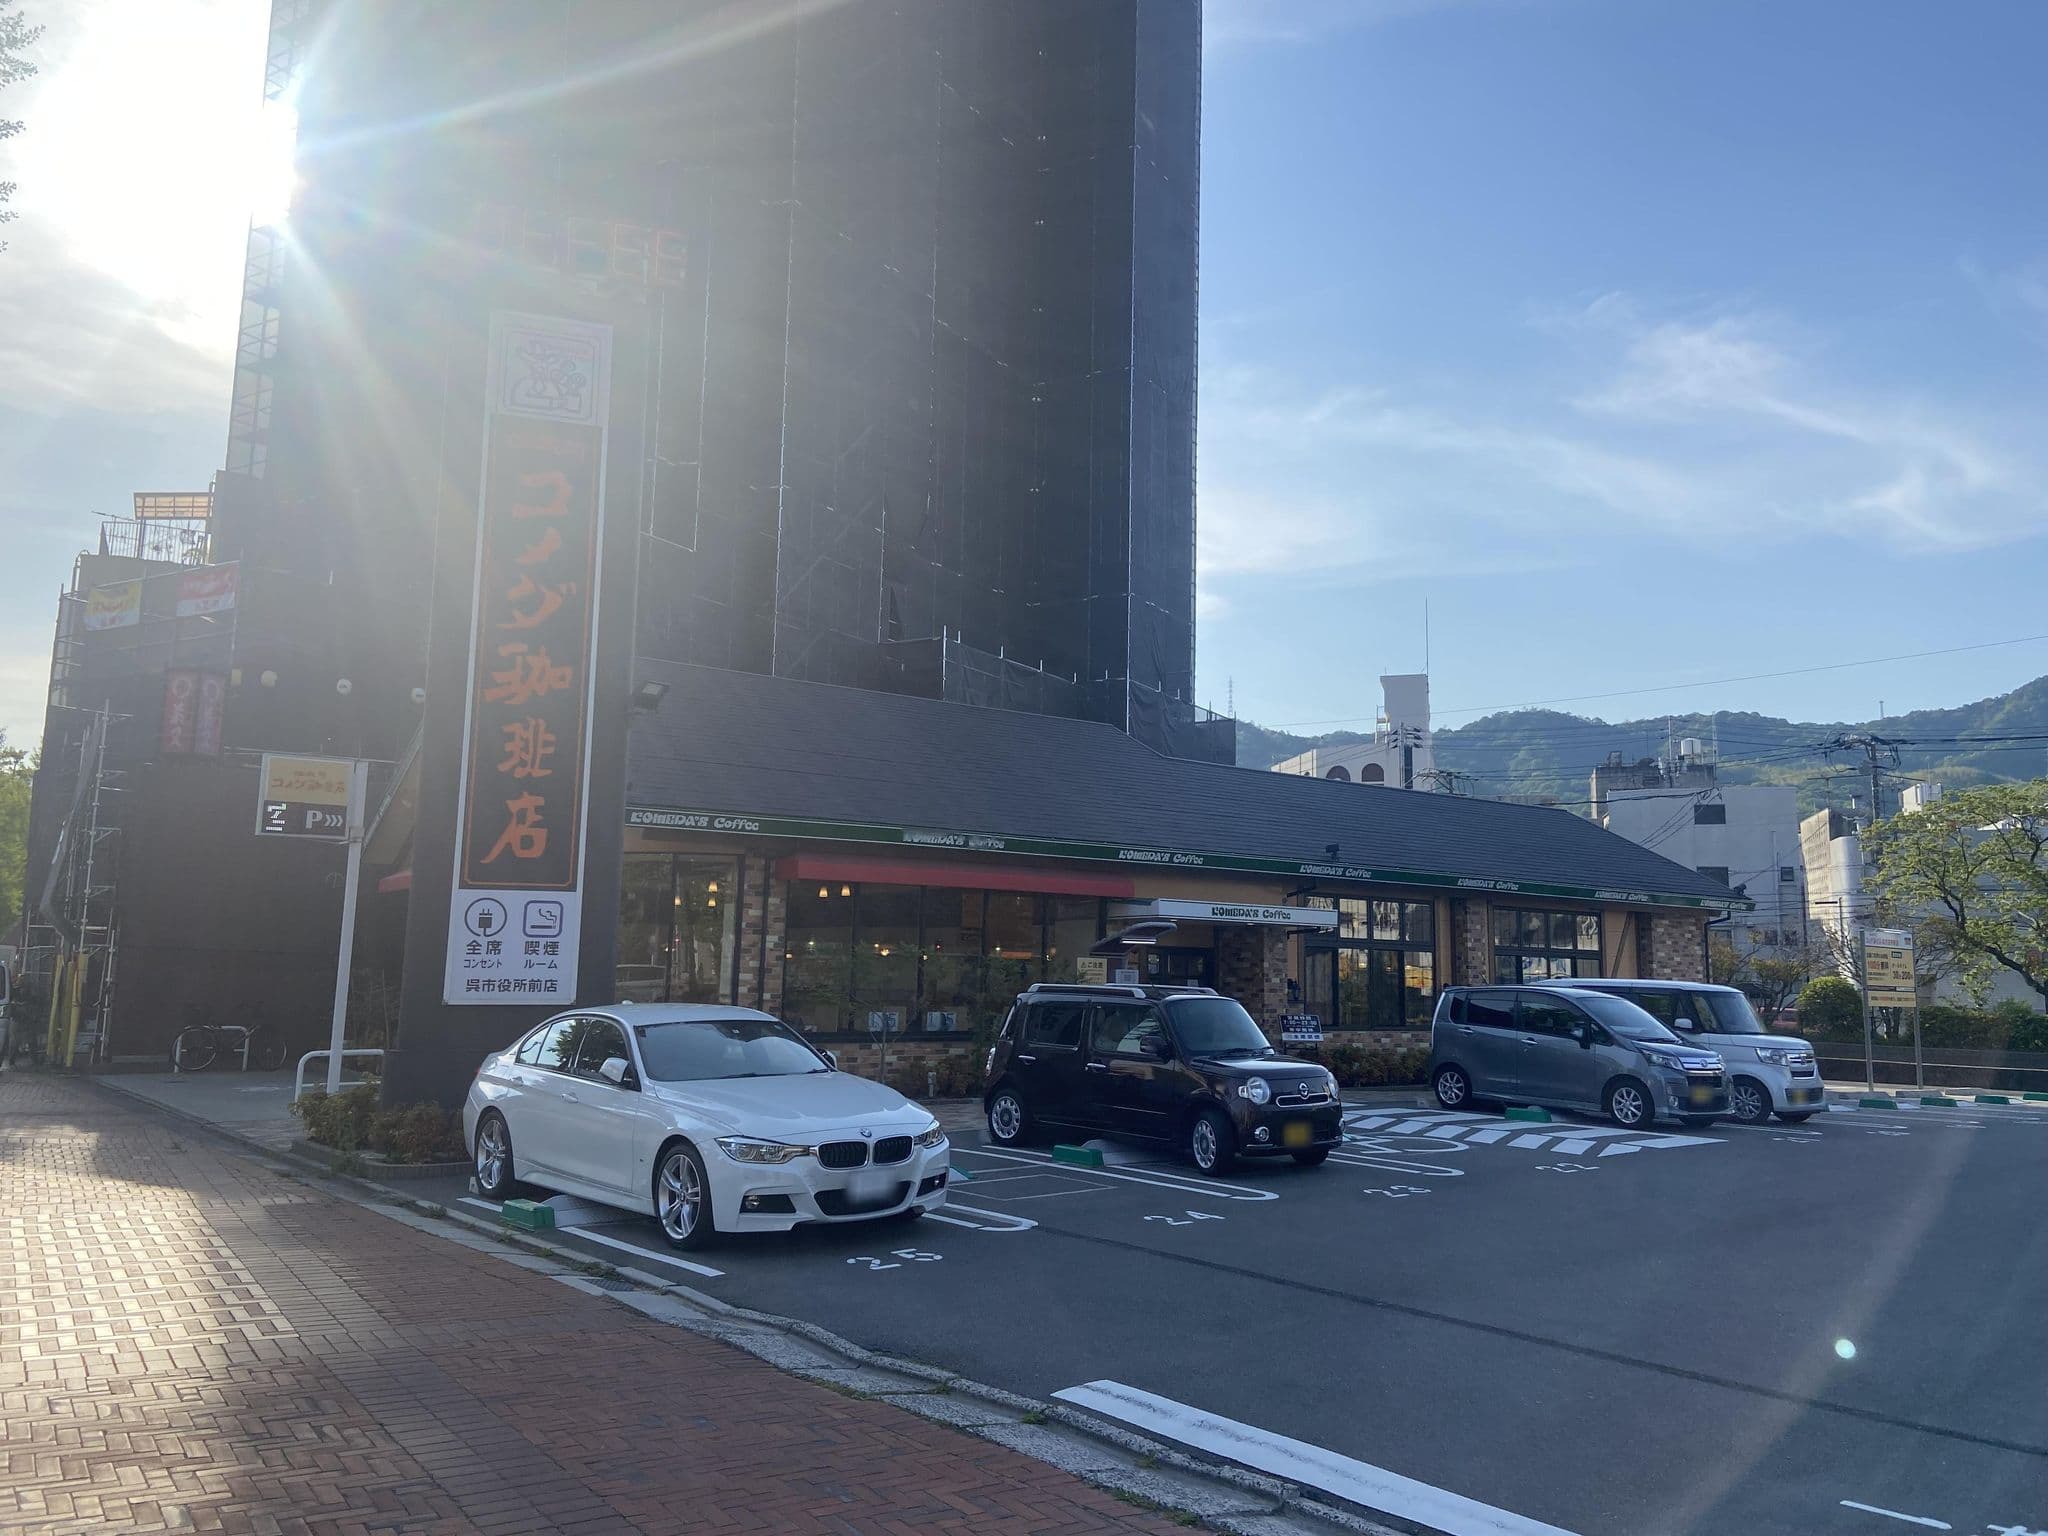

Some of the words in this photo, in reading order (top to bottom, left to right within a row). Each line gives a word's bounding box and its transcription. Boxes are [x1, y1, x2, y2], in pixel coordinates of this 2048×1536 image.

[305, 810, 323, 829] P
[630, 811, 709, 827] KOMEDA'S
[713, 817, 760, 832] Coffee
[1119, 850, 1171, 862] KOMEDA'S
[1173, 853, 1204, 865] Coffee
[1345, 868, 1372, 878] Coffee
[1211, 906, 1260, 918] KOMEDA'S
[1262, 909, 1292, 920] Coffee
[466, 939, 503, 956] 全席
[524, 941, 560, 956] 喫煙
[463, 959, 503, 969] コンセント
[523, 959, 558, 969] ルーム
[465, 978, 558, 993] 呉市役所前店
[1143, 1210, 1226, 1226] 24
[846, 1248, 943, 1270] 25
